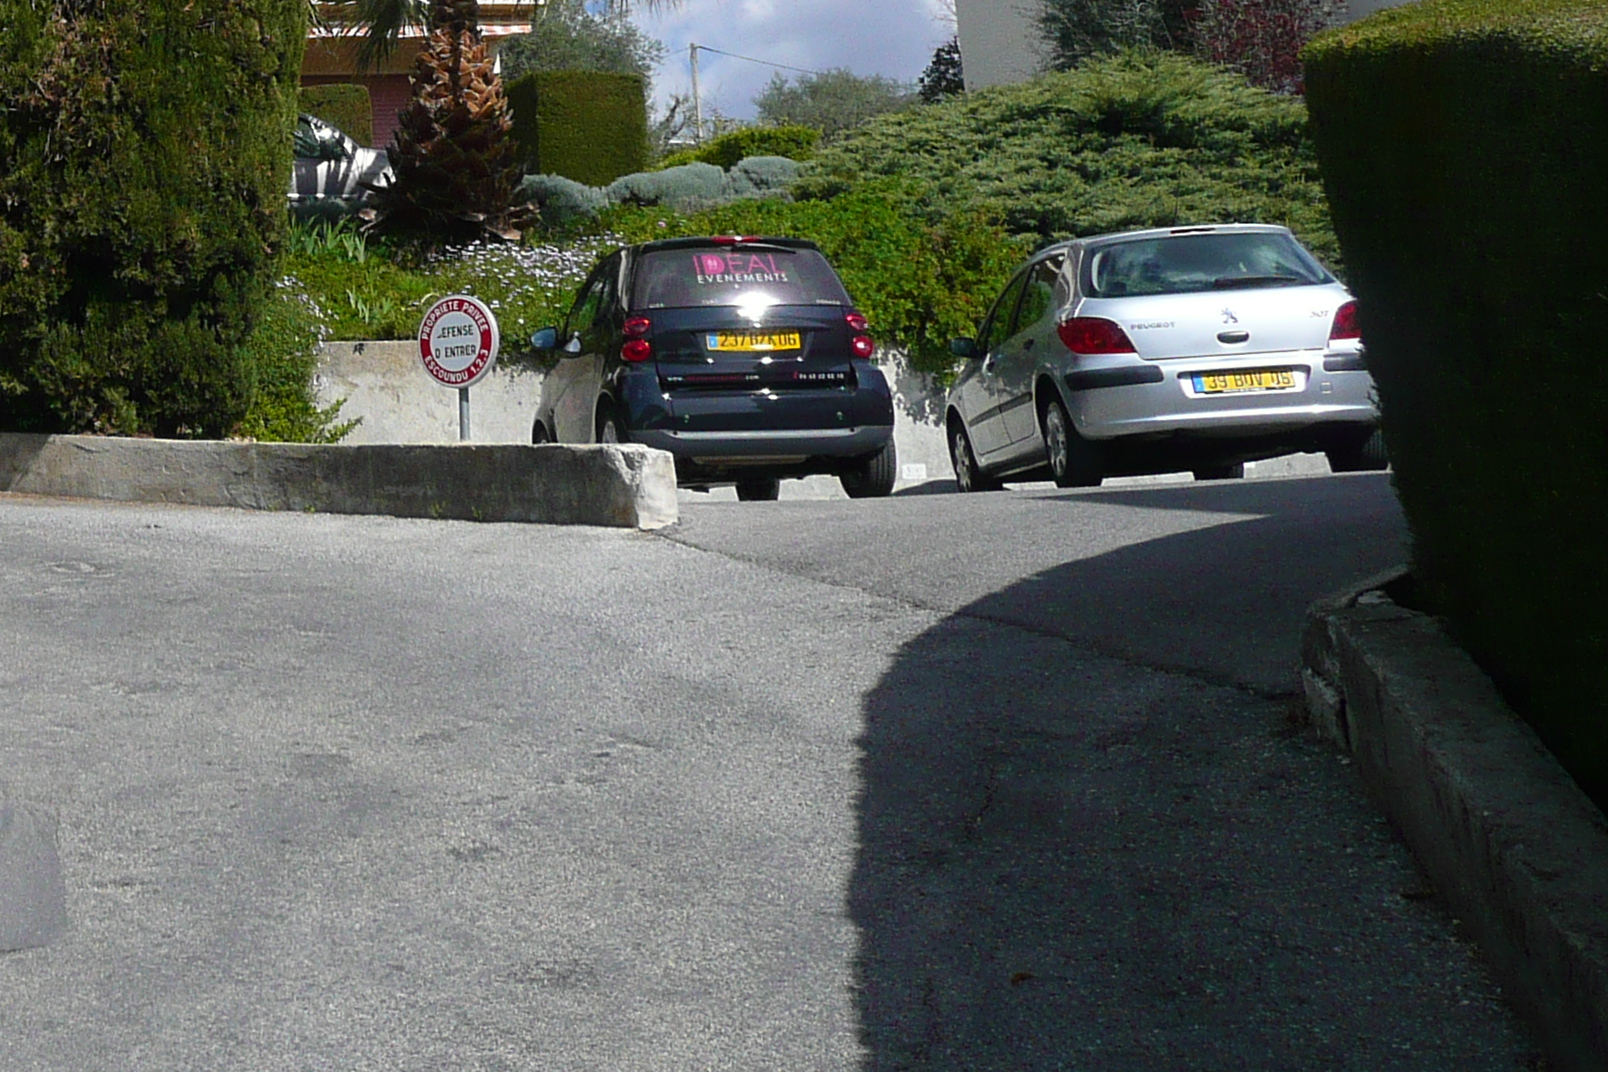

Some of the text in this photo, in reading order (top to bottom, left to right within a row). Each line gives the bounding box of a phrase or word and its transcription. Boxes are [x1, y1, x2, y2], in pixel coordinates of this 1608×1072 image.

[693, 254, 786, 274] IDEAL
[697, 273, 788, 284] EVENEMENTS
[422, 301, 488, 339] PROPRIETE PRIVEE
[1130, 321, 1175, 330] PEUGEOT
[779, 330, 797, 346] 06
[445, 345, 476, 358] ENTRER
[425, 356, 469, 382] ESCOUNDU
